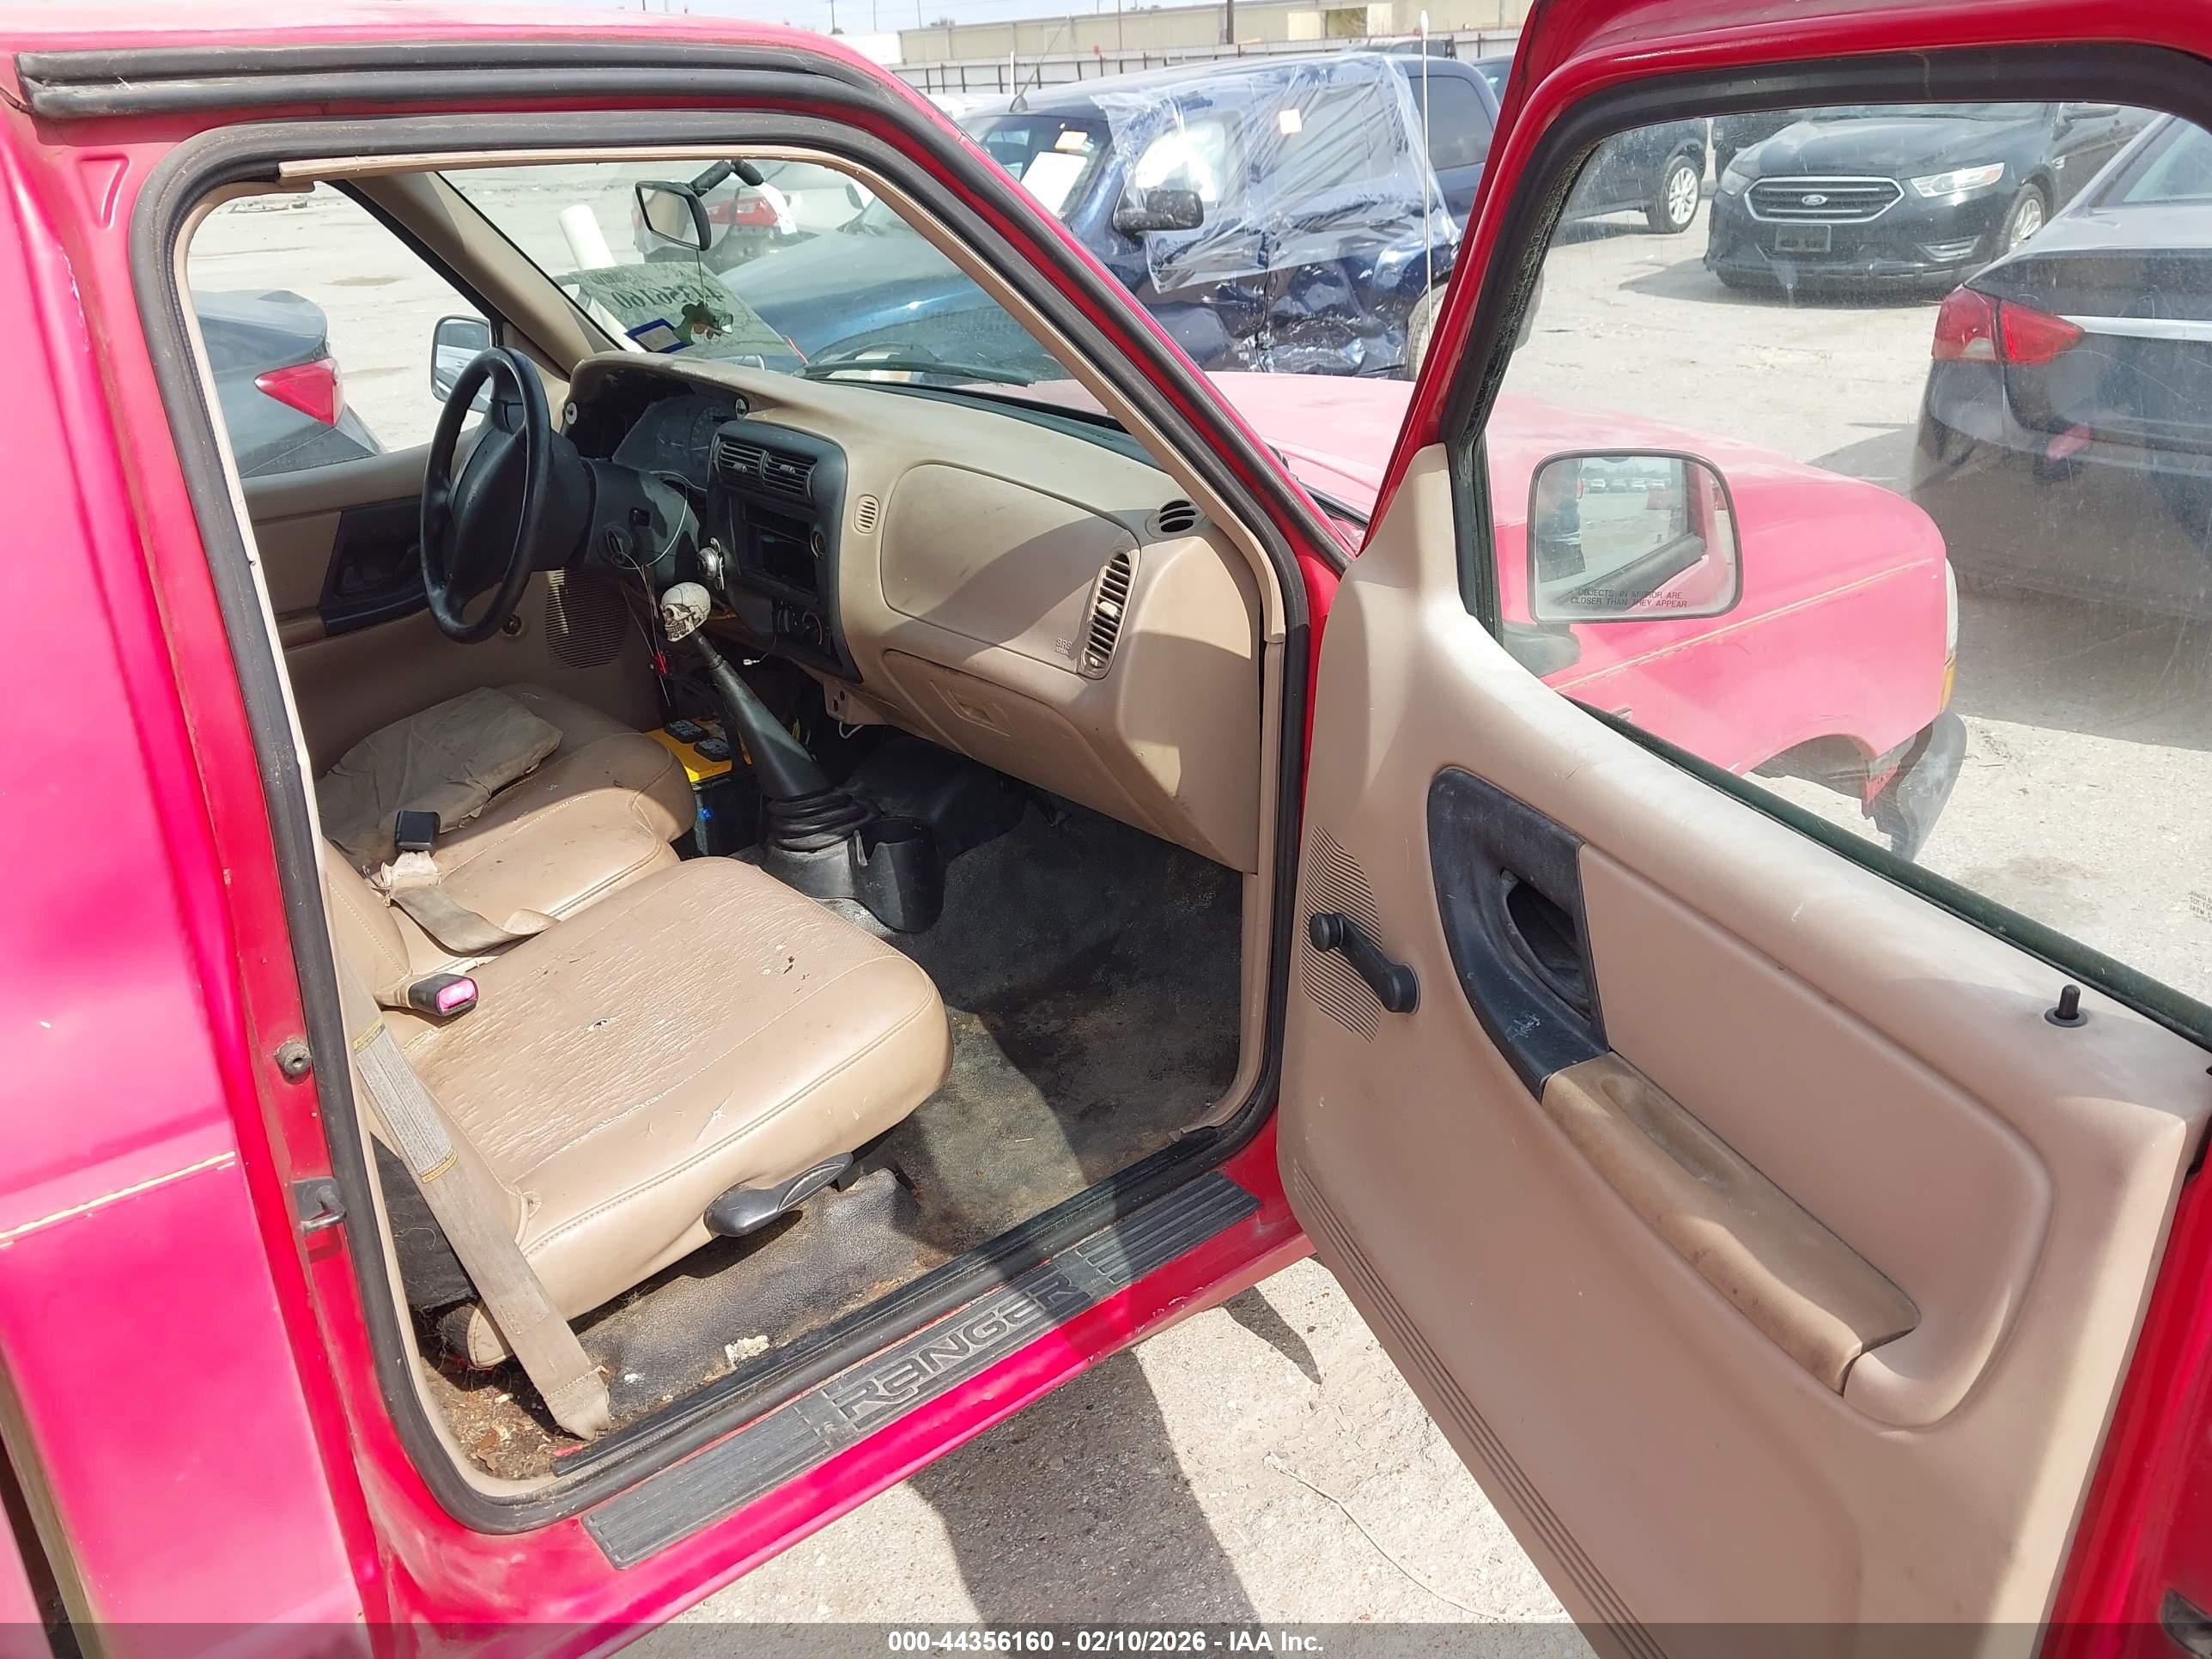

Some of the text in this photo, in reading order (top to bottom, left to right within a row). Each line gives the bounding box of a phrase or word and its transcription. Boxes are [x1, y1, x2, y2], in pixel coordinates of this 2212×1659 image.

[1633, 590, 1662, 599] MIRROR
[1571, 596, 1602, 605] CLOSER
[1607, 598, 1628, 606] THAN
[828, 1274, 1093, 1420] RANGER
